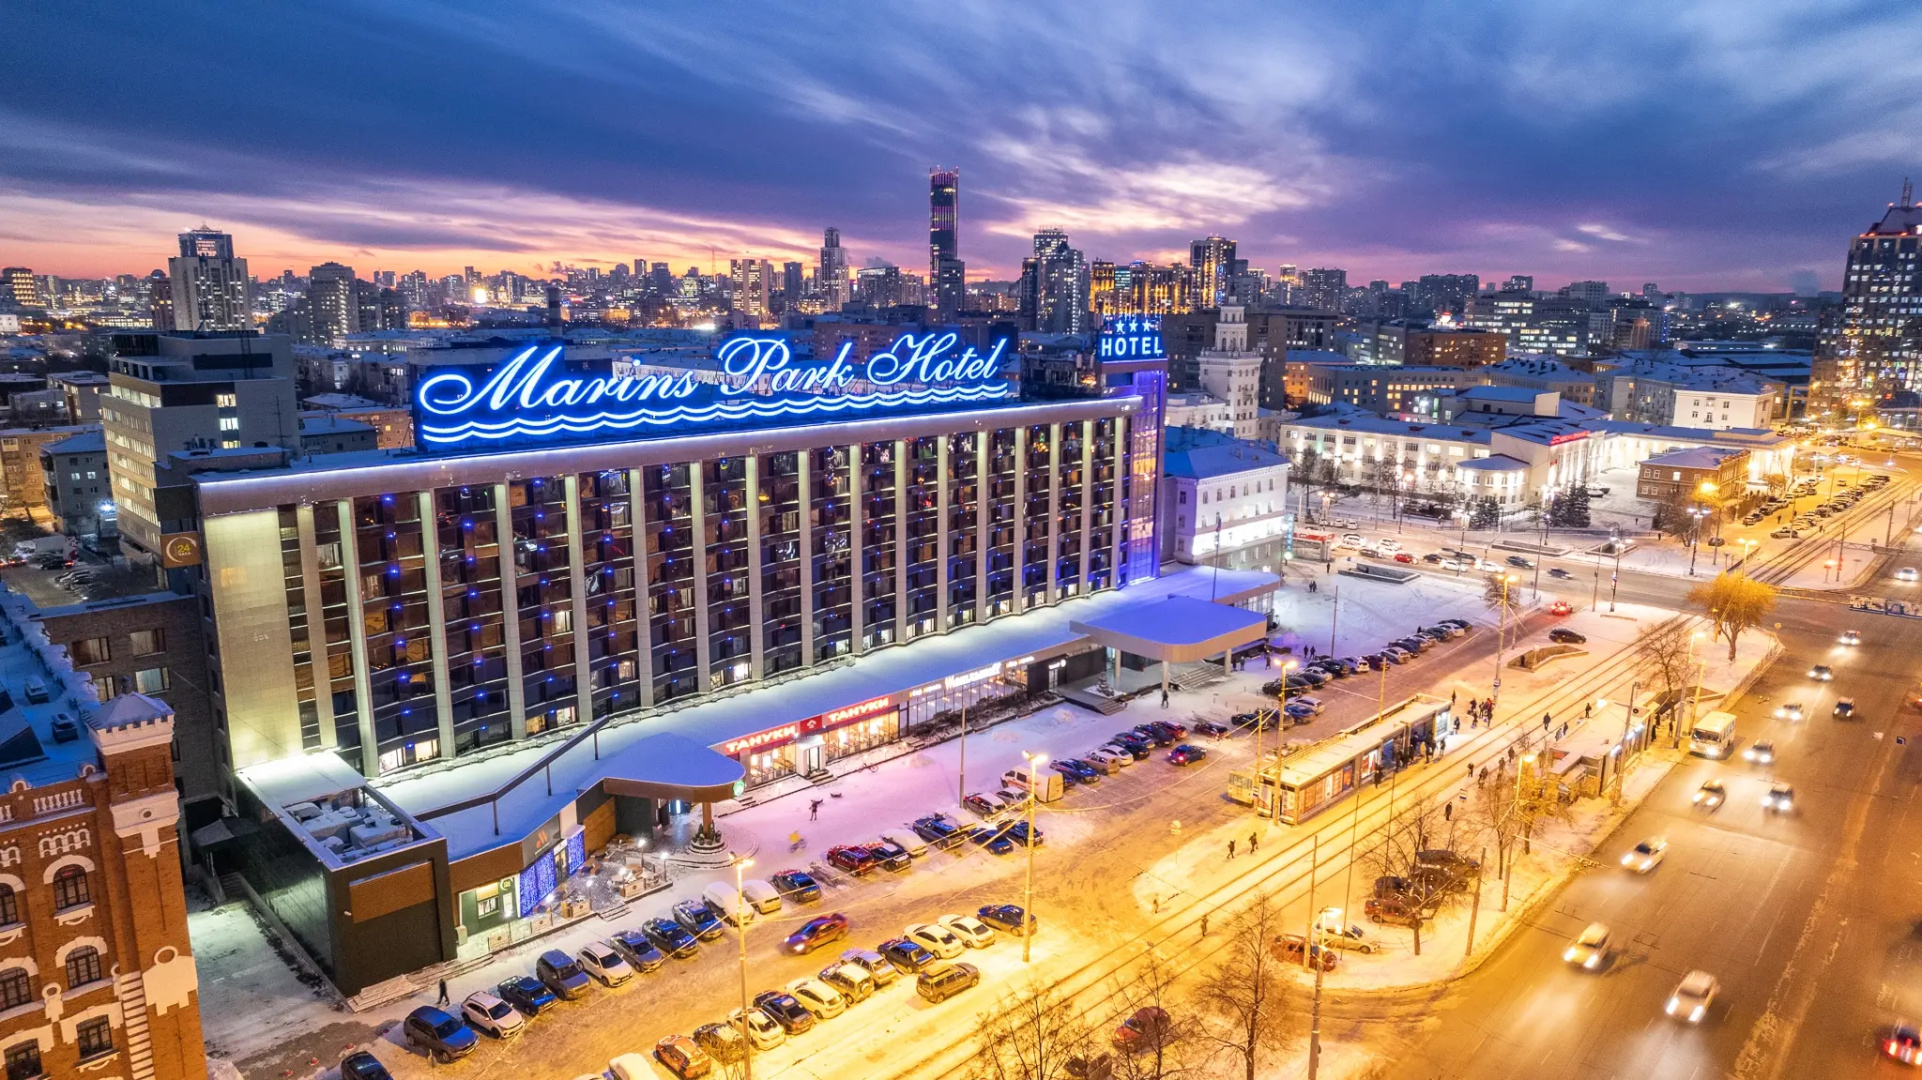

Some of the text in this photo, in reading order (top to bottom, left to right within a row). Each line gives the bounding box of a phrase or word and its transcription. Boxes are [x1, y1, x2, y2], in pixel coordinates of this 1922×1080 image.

[1101, 336, 1163, 357] HOTEL
[419, 333, 1007, 415] Marins Park Hotel
[177, 544, 192, 553] 24
[827, 697, 889, 723] ТАНУКИ
[726, 725, 796, 752] ТАНУКИ
